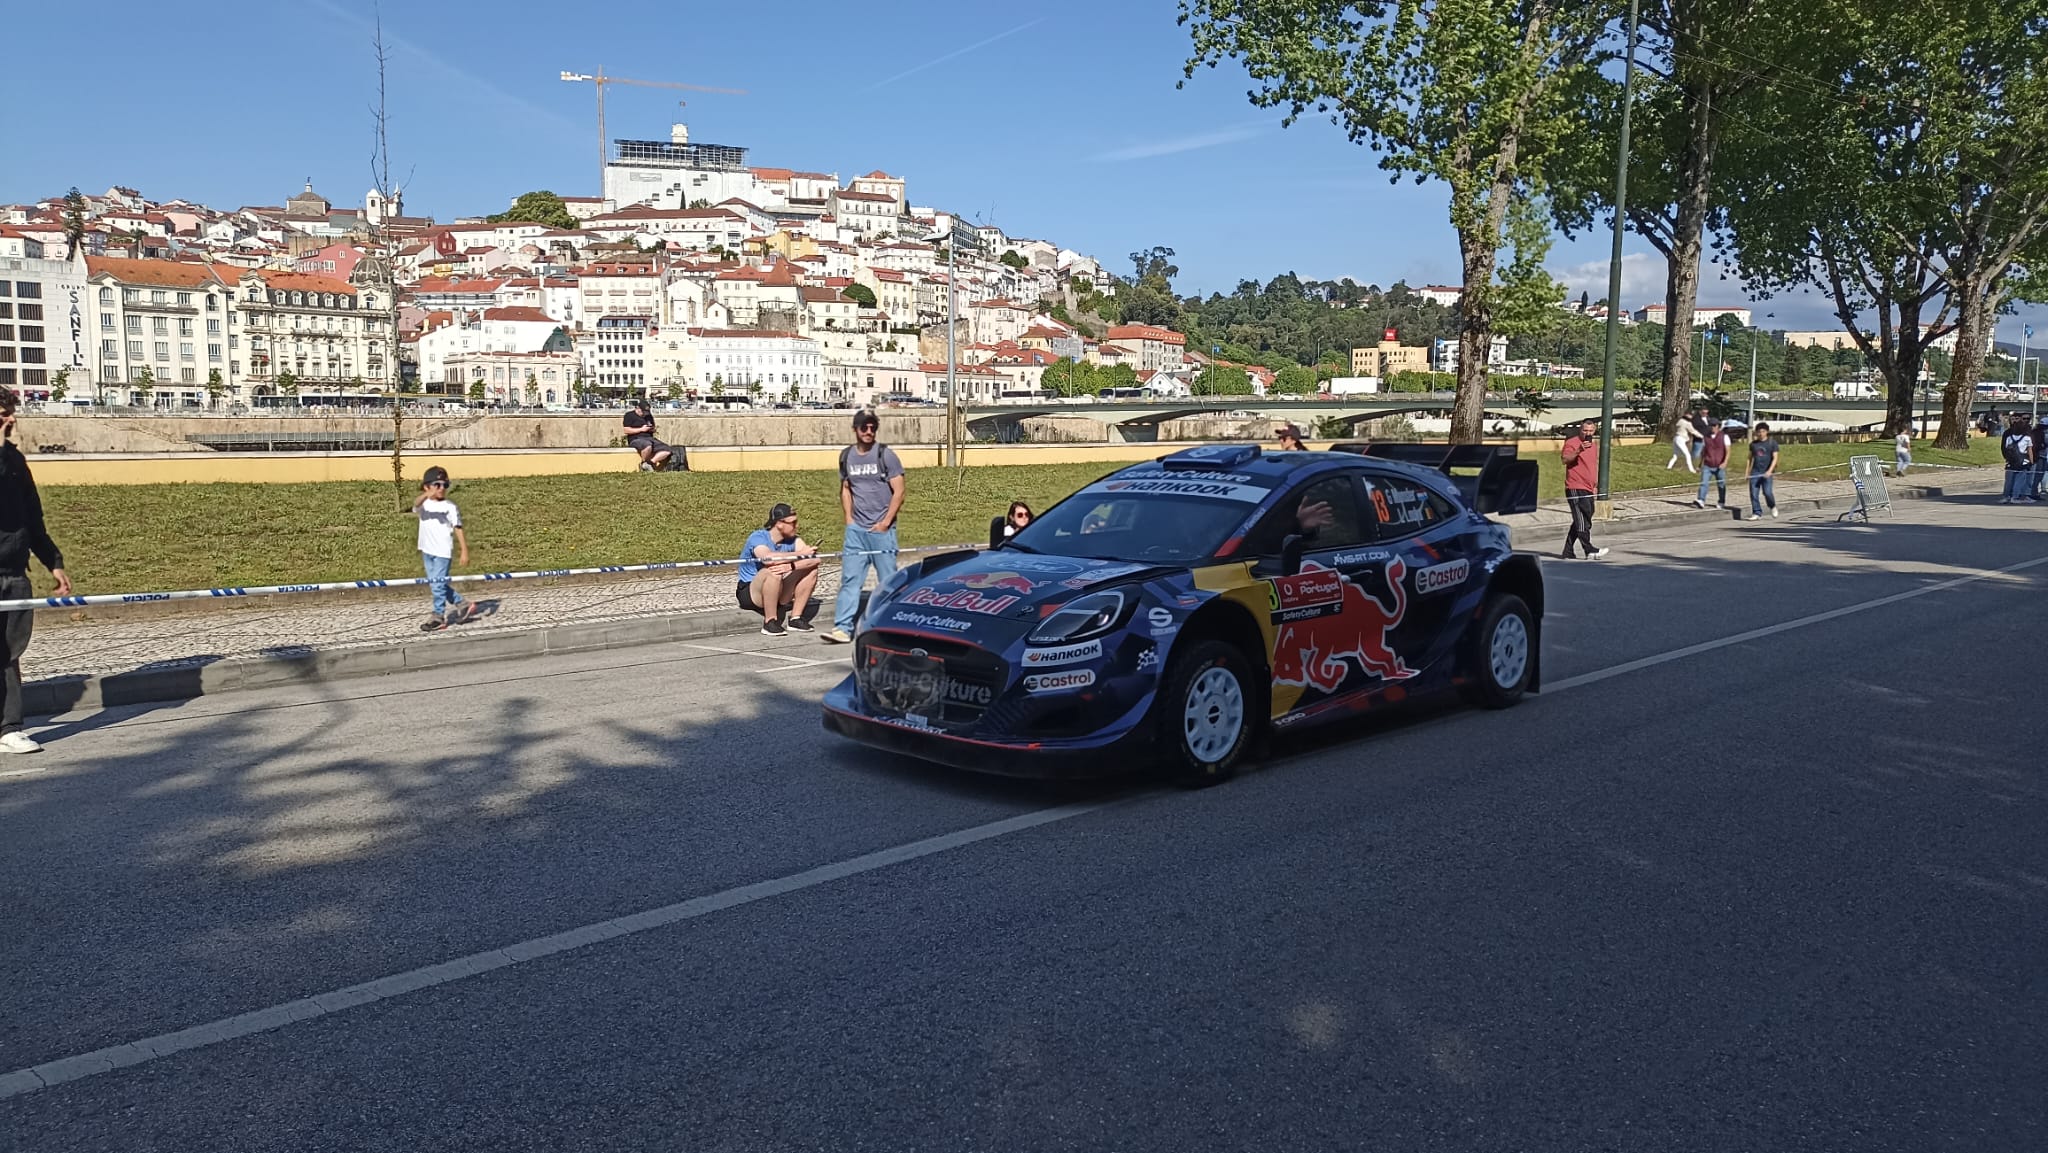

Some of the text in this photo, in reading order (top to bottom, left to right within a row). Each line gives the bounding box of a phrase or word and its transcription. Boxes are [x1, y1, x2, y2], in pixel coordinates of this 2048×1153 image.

[69, 291, 83, 366] SANFIL
[1370, 490, 1390, 523] 13
[1429, 565, 1468, 587] Castrol
[1300, 582, 1339, 594] Portugal
[892, 610, 972, 631] SafetyCulture
[1040, 672, 1091, 689] Castrol
